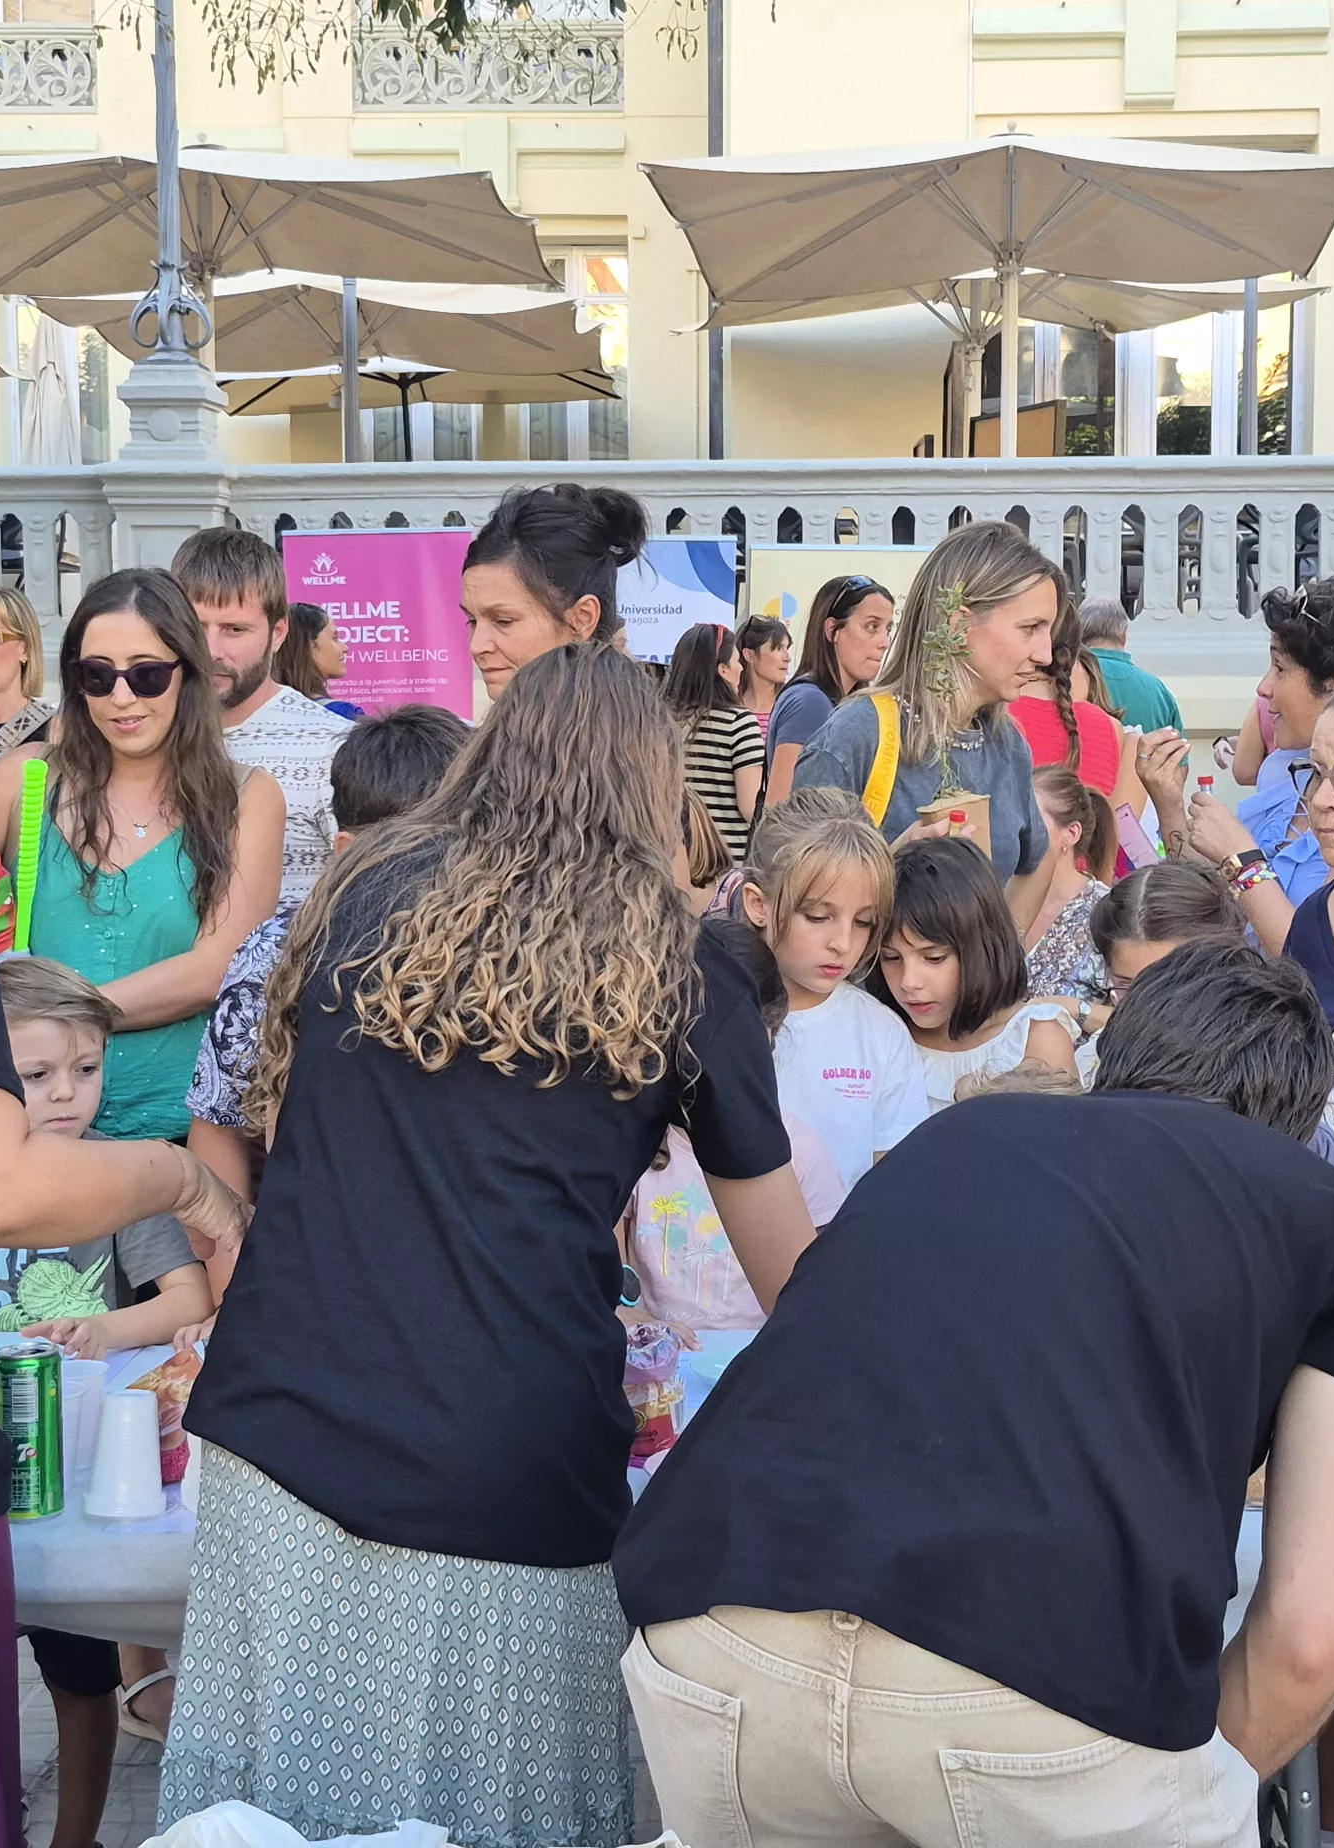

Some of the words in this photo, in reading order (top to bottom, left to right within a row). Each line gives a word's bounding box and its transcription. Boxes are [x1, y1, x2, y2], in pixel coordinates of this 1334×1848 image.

[302, 576, 347, 586] WELLME
[624, 617, 659, 626] ragoza
[336, 625, 410, 644] OJECT:
[358, 649, 449, 663] WELLBEING
[372, 678, 408, 687] juventud
[822, 1067, 857, 1079] GOLDEN
